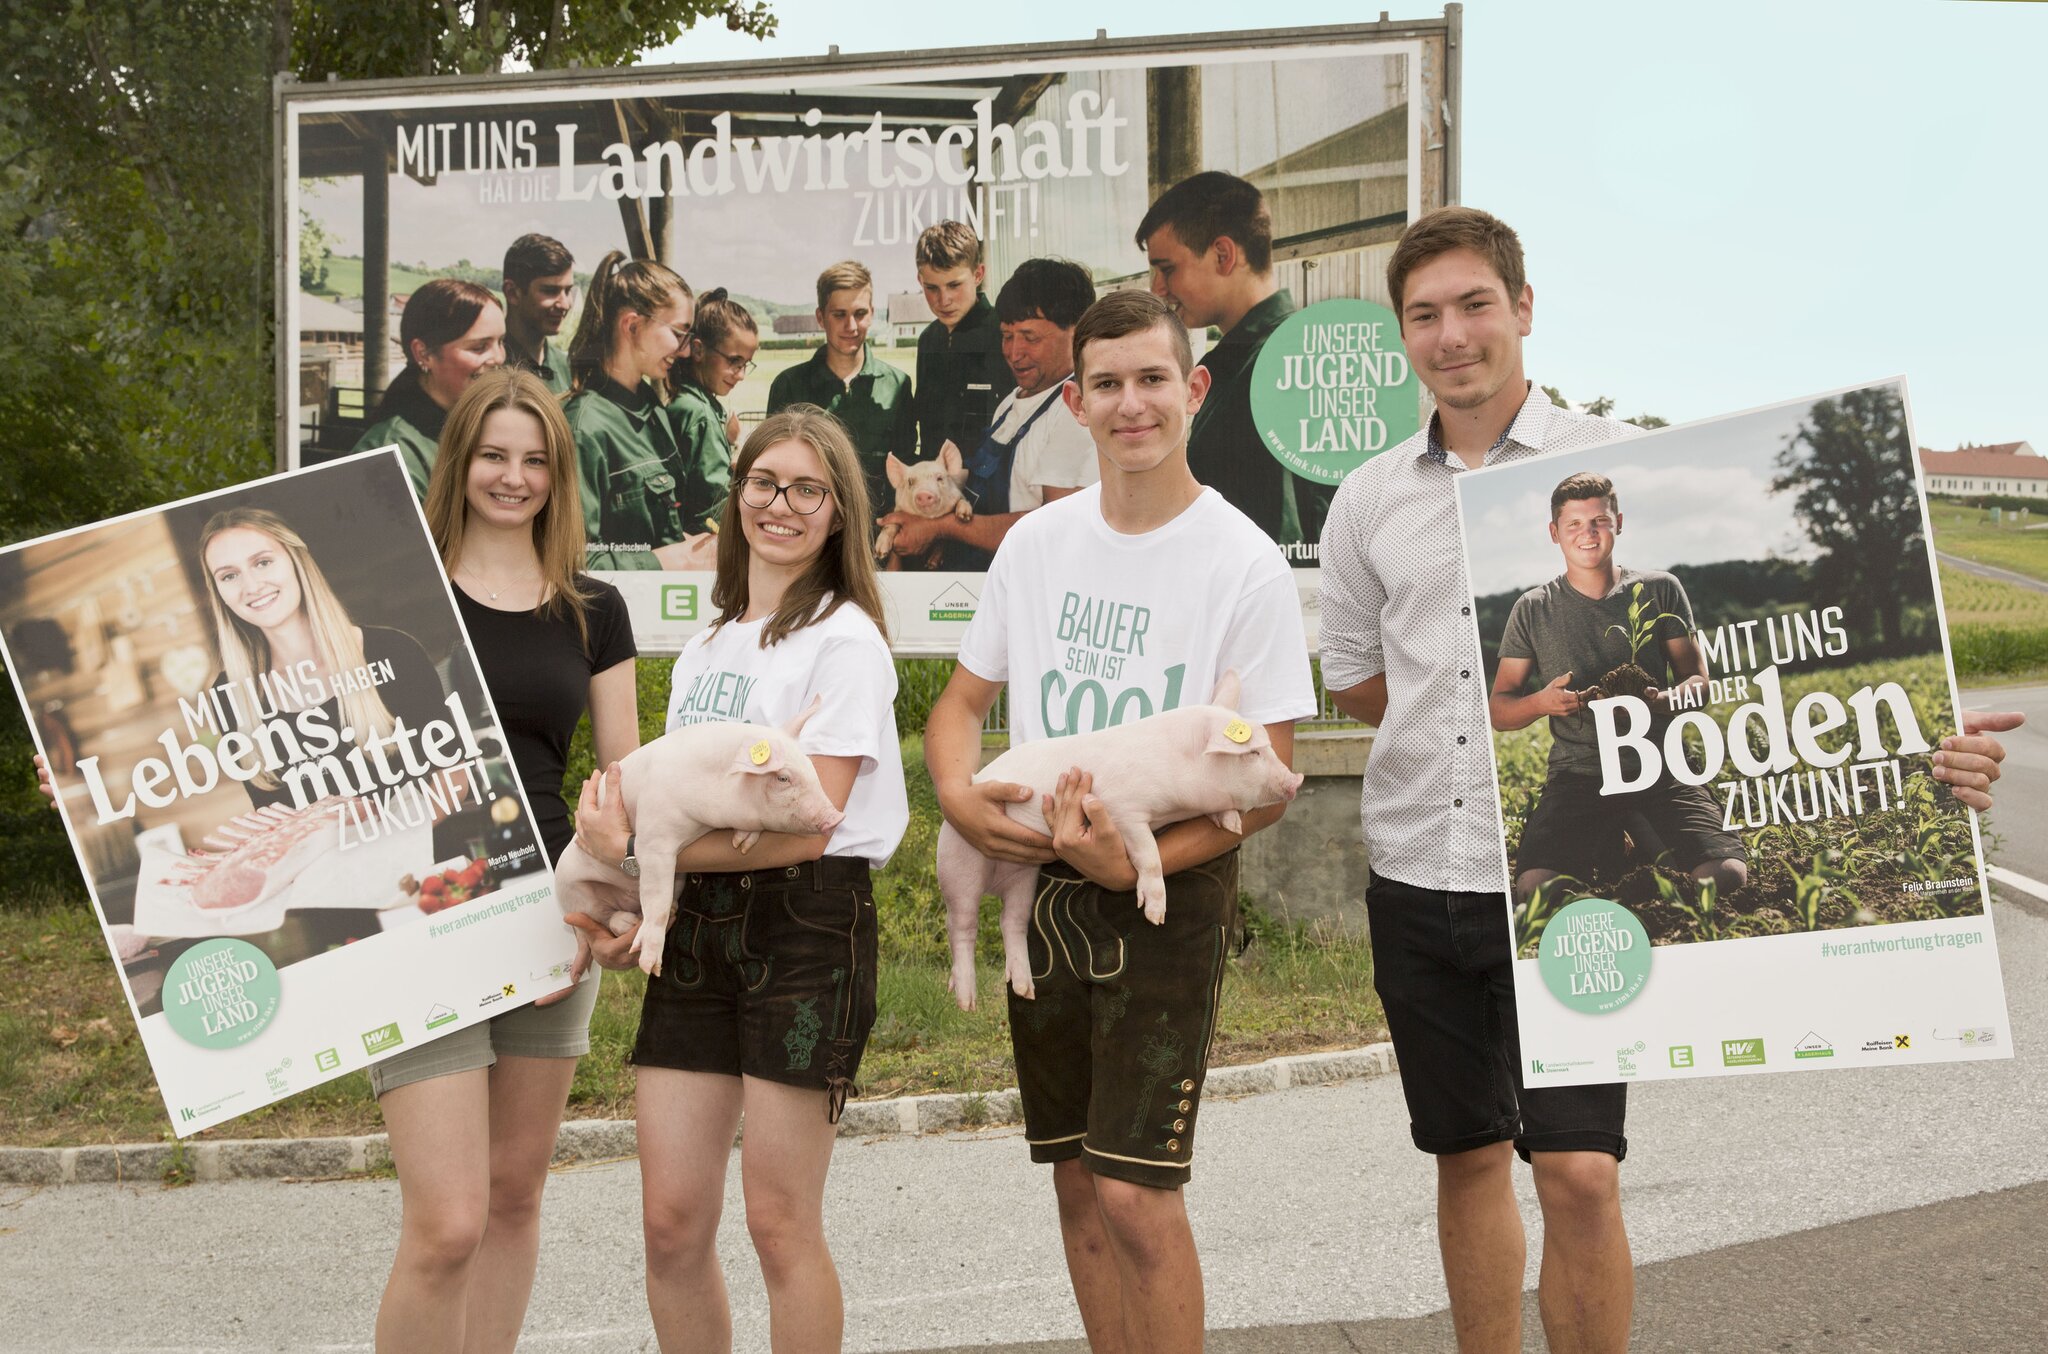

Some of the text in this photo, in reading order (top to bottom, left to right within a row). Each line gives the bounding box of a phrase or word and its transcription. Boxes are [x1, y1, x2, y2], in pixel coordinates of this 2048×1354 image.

[397, 119, 537, 177] MIT UNS
[555, 89, 1130, 201] Landwirtschaft
[480, 173, 552, 204] HAT DIE
[853, 182, 1039, 246] ZUKUNFT!
[1303, 322, 1384, 355] UNSERE
[1276, 351, 1409, 391] JUGEND
[1308, 387, 1377, 419] UNSER
[1299, 416, 1388, 453] LAND
[610, 542, 651, 552] Fachschule
[1057, 591, 1151, 657] BAUER
[1697, 606, 1849, 676] MIT UNS
[1065, 647, 1126, 681] SEIN IST
[178, 658, 396, 741] MIT UNS HABEN
[1668, 675, 1750, 712] HAT DER
[1588, 664, 1931, 797] Boden
[76, 706, 339, 826] Lebens
[283, 691, 483, 810] mittel
[328, 758, 497, 852] ZUKUNFT!
[1718, 759, 1906, 832] ZUKUNFT!
[488, 853, 508, 867] Maria
[508, 843, 536, 859] Neuhold
[1902, 876, 1974, 893] Felix Braunstein
[1566, 911, 1617, 935] UNSERE
[1553, 929, 1633, 958] JUGEND
[185, 947, 238, 979] UNSERE
[1574, 952, 1617, 974] UNSER
[178, 960, 258, 1005] JUGEND
[201, 984, 248, 1014] UNSER
[1569, 970, 1625, 995] LAND
[201, 1000, 258, 1036] LAND
[1617, 1048, 1635, 1056] side
[1617, 1055, 1628, 1066] by
[1618, 1063, 1637, 1071] side
